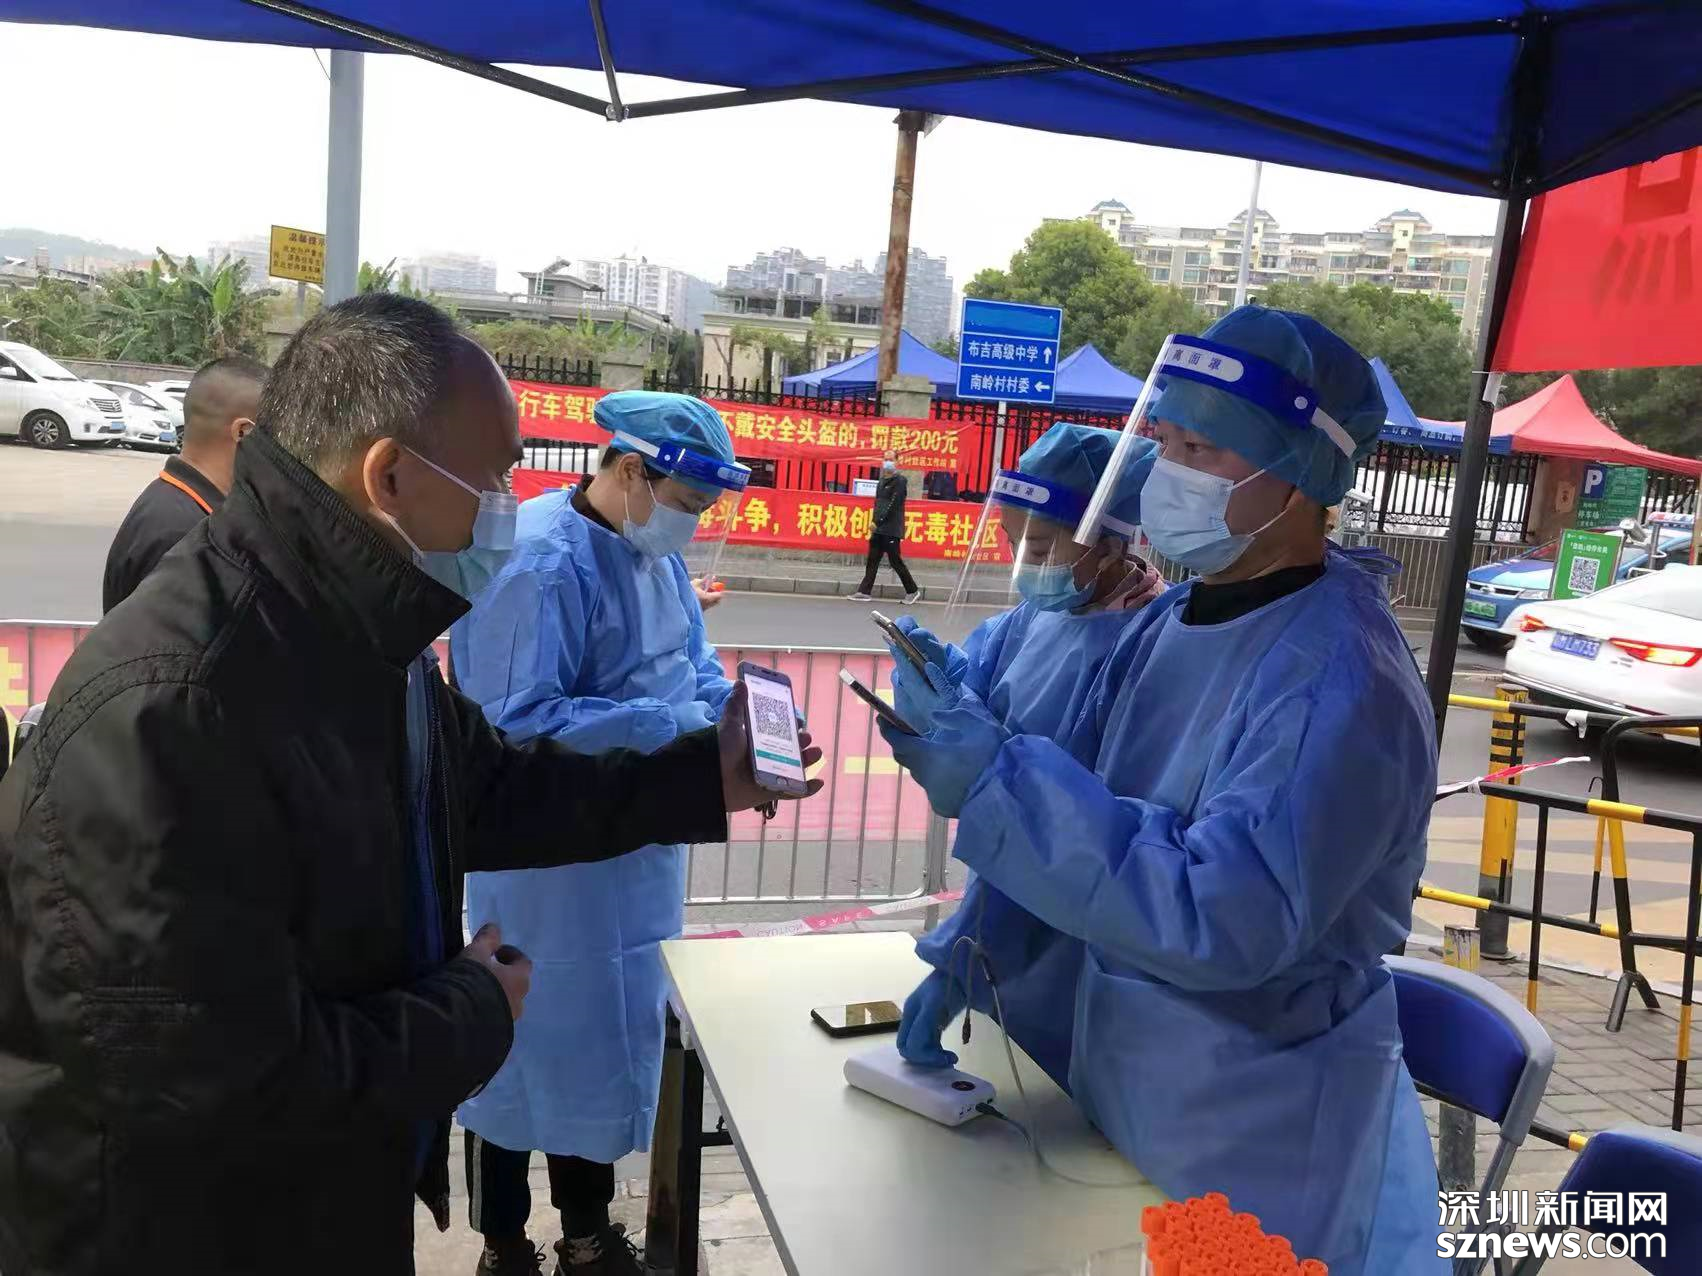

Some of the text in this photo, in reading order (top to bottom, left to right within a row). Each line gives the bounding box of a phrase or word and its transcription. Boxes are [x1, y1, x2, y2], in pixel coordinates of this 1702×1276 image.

[968, 340, 1039, 363] 布吉高级中学
[970, 373, 1030, 394] 南岭村村委
[1584, 469, 1603, 494] P
